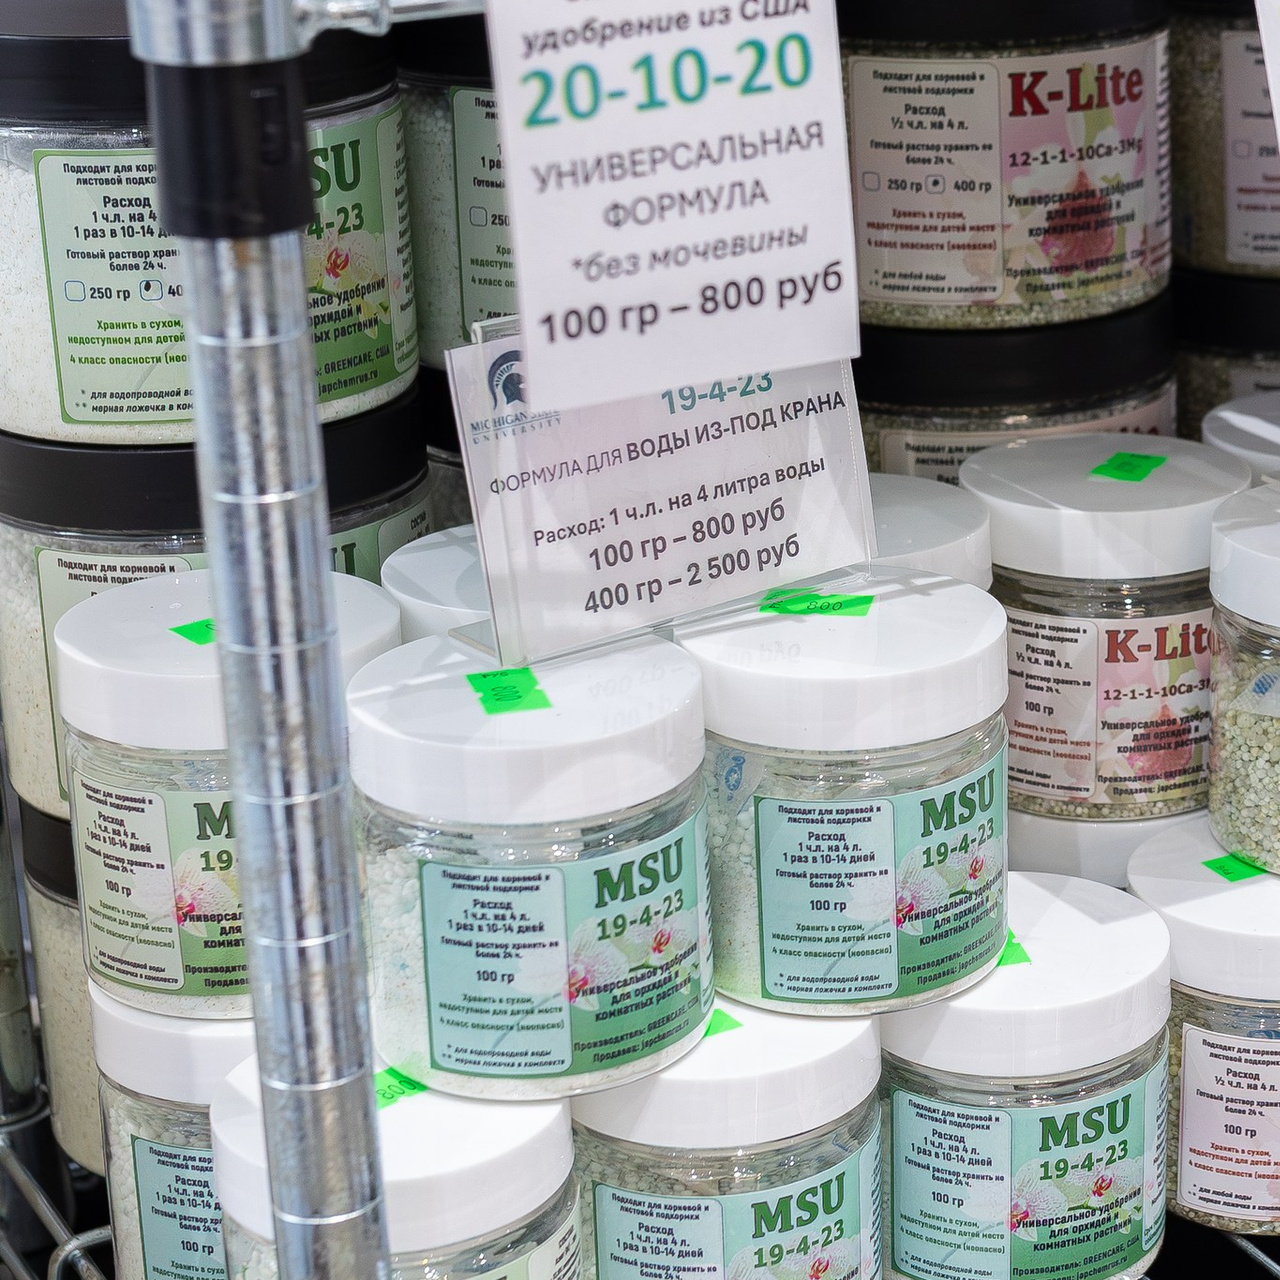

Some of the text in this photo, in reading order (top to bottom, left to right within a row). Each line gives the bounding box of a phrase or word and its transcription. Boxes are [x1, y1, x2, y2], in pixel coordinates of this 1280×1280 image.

[521, 33, 813, 128] 20-10-20
[1008, 63, 1144, 119] K-Lite
[531, 123, 825, 194] УНИВЕРСАЛЬНАЯ
[102, 195, 151, 210] Расход
[603, 181, 769, 228] ФОРМУЛА
[648, 226, 808, 266] мочевины
[89, 285, 131, 301] 250 гр
[540, 262, 842, 345] 100 гр 800 руб
[490, 391, 846, 495] ФОРМУЛА ДЛЯ ВОДЫ ИЗ-ПОД КРАНА
[806, 600, 843, 612] 800
[920, 768, 996, 837] MSU
[790, 854, 808, 865] раз
[812, 856, 818, 864] в
[820, 853, 845, 864] 10-14
[848, 852, 875, 865] дней
[922, 817, 995, 869] 19-4-23
[809, 900, 846, 915] 100 гр
[1038, 1094, 1131, 1152] MSU
[1039, 1139, 1128, 1181] 19-4-23
[750, 1173, 846, 1240] MSU
[752, 1219, 845, 1270] 19-4-23
